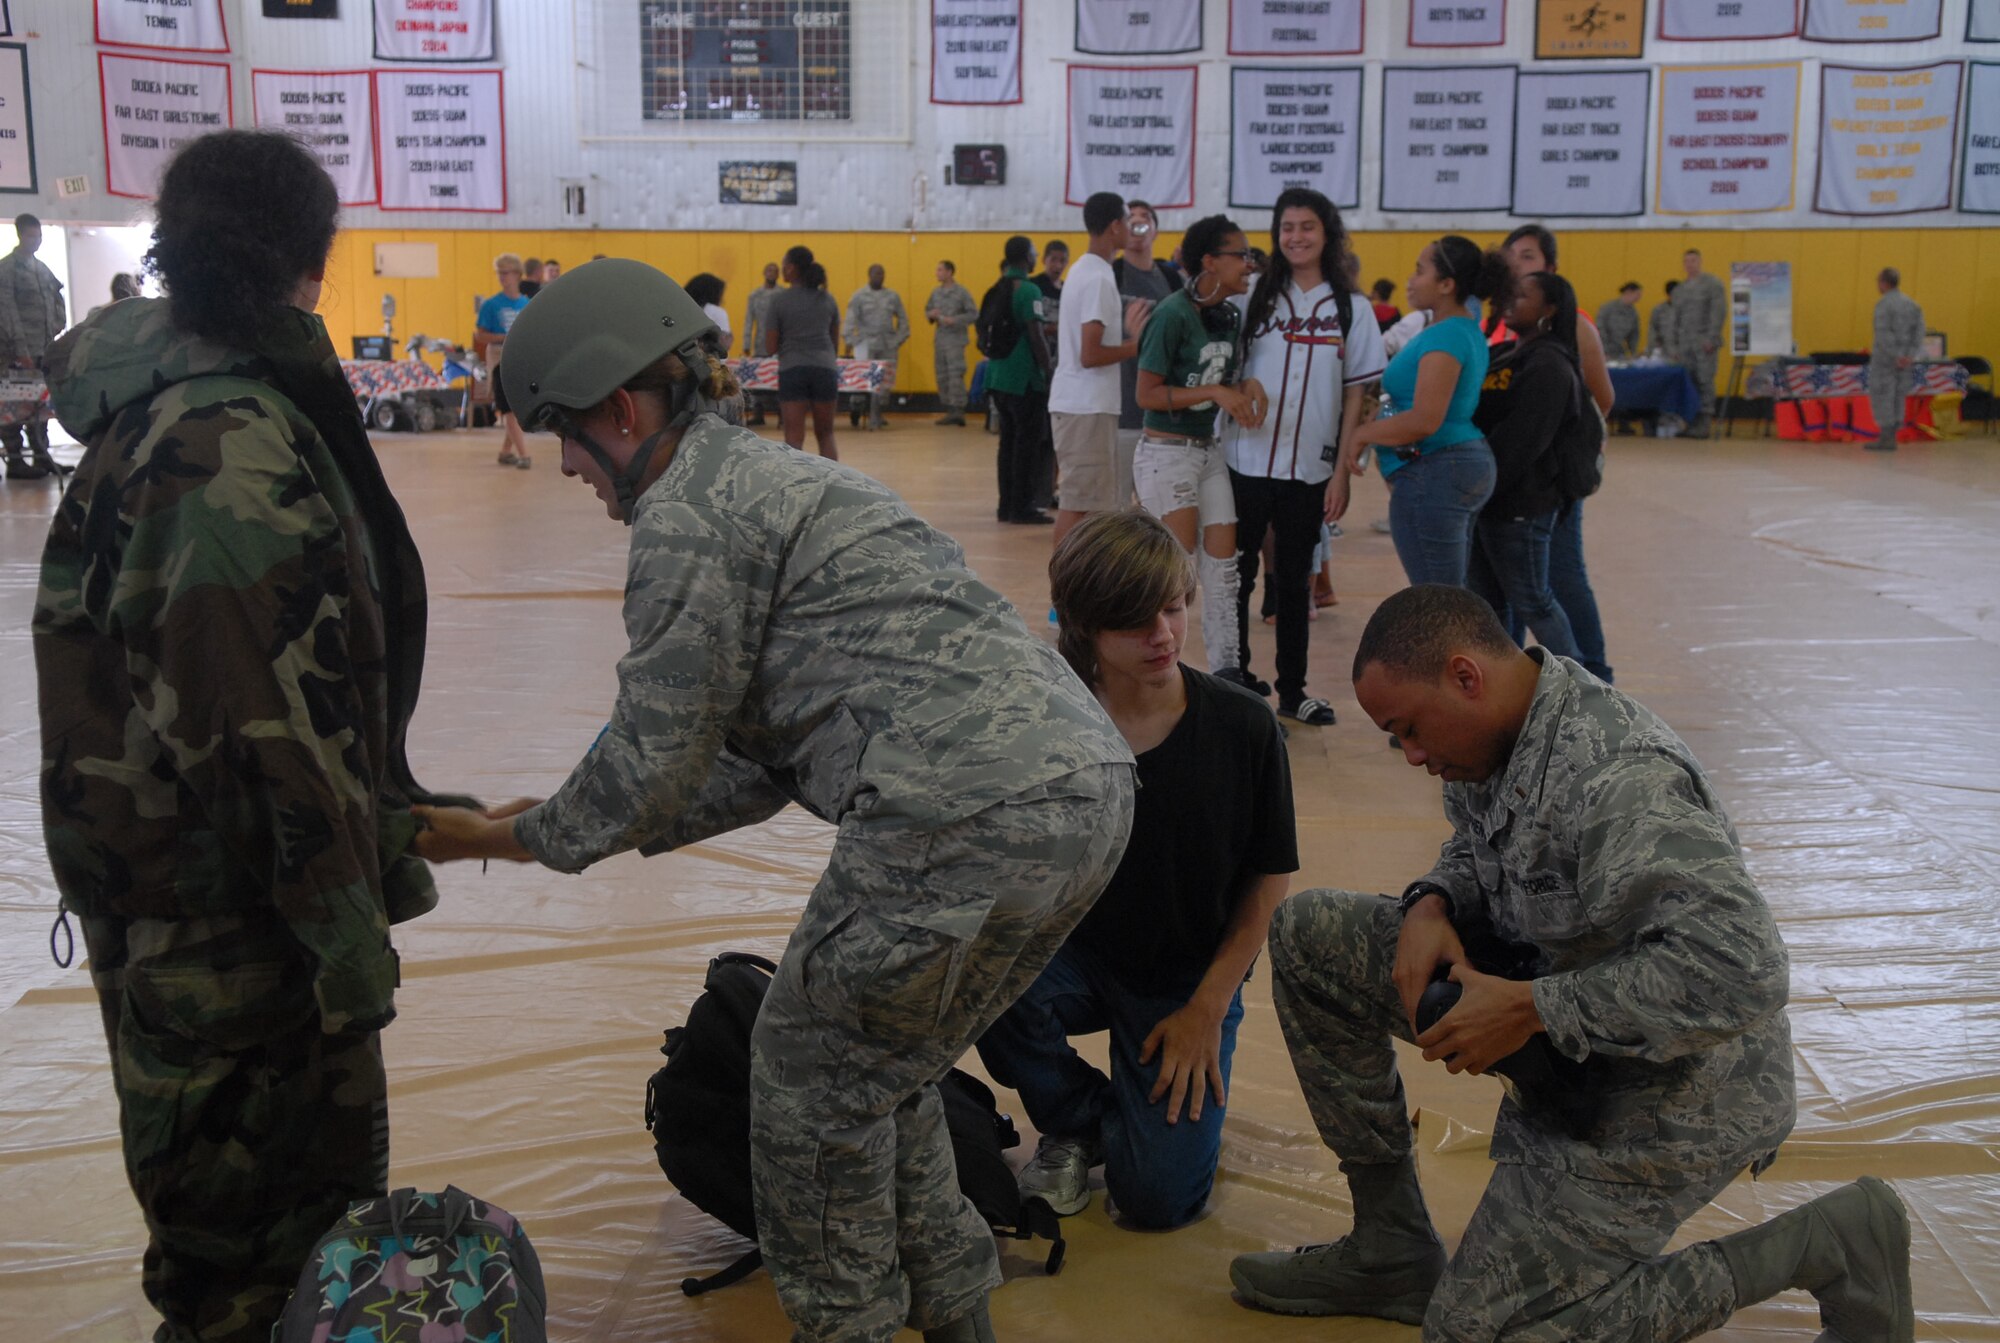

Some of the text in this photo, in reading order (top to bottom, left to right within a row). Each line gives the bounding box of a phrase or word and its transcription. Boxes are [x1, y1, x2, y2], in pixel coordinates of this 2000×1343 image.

[650, 11, 841, 28] HOME GUEST
[1428, 8, 1487, 21] BOYS TRACK
[145, 15, 178, 29] TENNIS
[437, 21, 469, 34] JAPAN
[1271, 28, 1317, 42] FOOTBALL
[955, 66, 998, 79] SOFTBALL
[131, 79, 199, 97] DODEA PACIFIC
[1130, 86, 1164, 100] PACIFIC
[1728, 86, 1765, 99] PACIFIC
[1447, 91, 1483, 105] PACIFIC
[1580, 96, 1617, 110] PACIFIC
[114, 104, 131, 119] FAR
[135, 107, 159, 122] EAST
[190, 112, 221, 125] TENNIS
[1131, 115, 1174, 129] SOFTBALL
[1270, 122, 1295, 135] EAST
[1297, 122, 1345, 136] FOOTBALL
[1428, 117, 1453, 131] EAST
[1456, 118, 1488, 131] TRACK
[1561, 123, 1586, 136] EAST
[1590, 122, 1621, 136] TRACK
[121, 133, 159, 149] DIVISION
[444, 135, 487, 148] CHAMPION
[1747, 133, 1789, 147] COUNTRY
[1408, 143, 1489, 157] BOYS CHAMPION
[1572, 148, 1620, 162] CHAMPION
[452, 159, 474, 173] EAST
[1269, 160, 1323, 174] CHAMPIONS
[1721, 157, 1769, 170] CHAMPION
[64, 177, 85, 194] EXIT
[1522, 874, 1561, 897] FORCE
